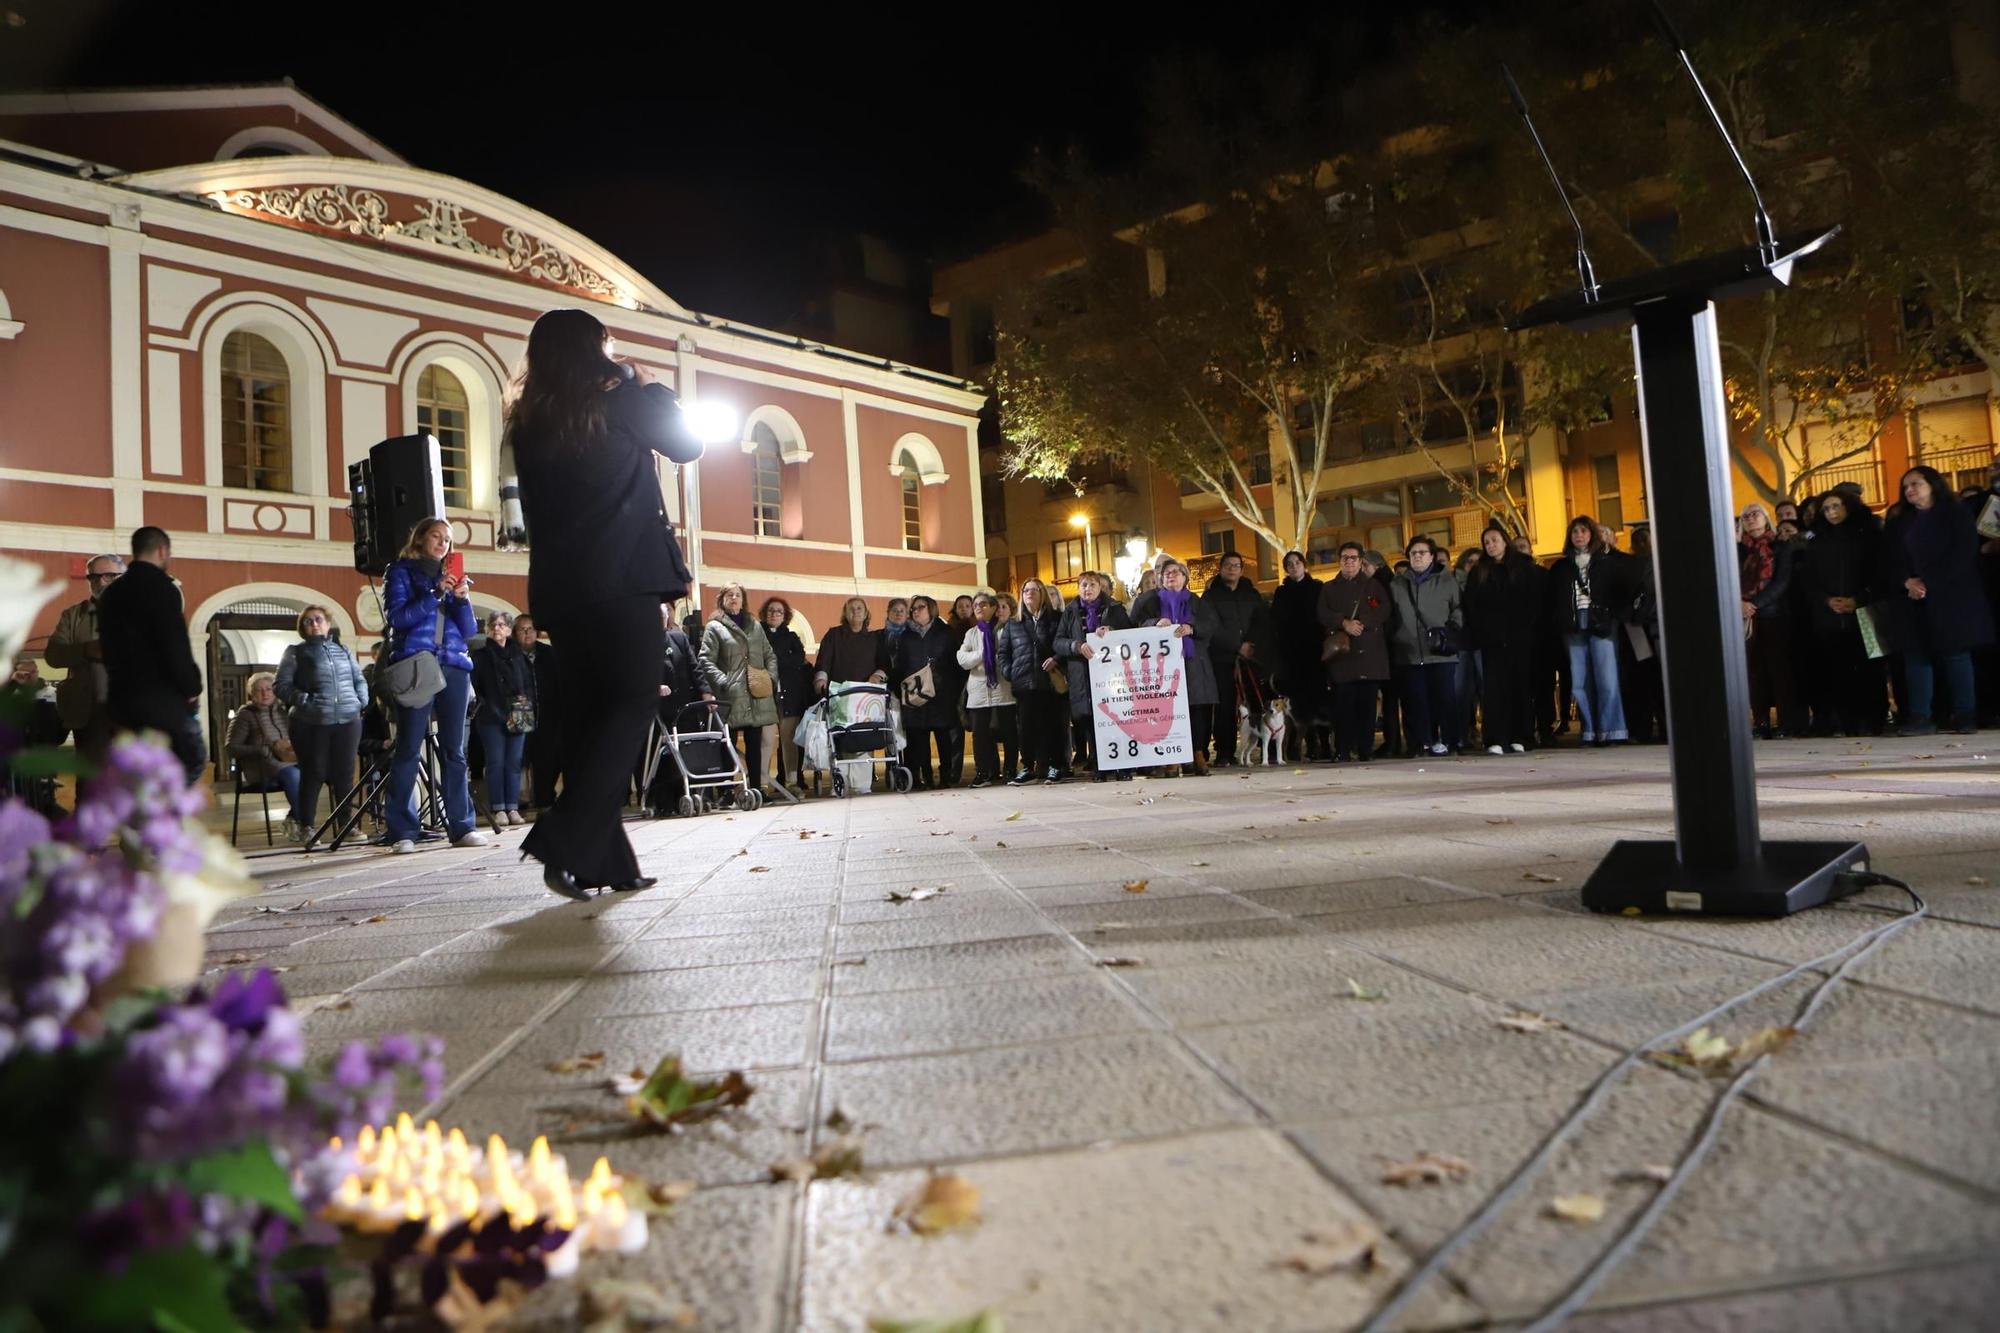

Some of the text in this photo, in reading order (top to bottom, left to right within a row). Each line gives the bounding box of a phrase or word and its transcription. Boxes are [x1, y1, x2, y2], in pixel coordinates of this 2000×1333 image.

[1100, 640, 1170, 663] 2025
[1111, 695, 1134, 704] TIENE
[1136, 690, 1178, 701] VIOLENCIA
[1122, 706, 1160, 717] VÍCTIMAS
[1166, 745, 1182, 754] 016
